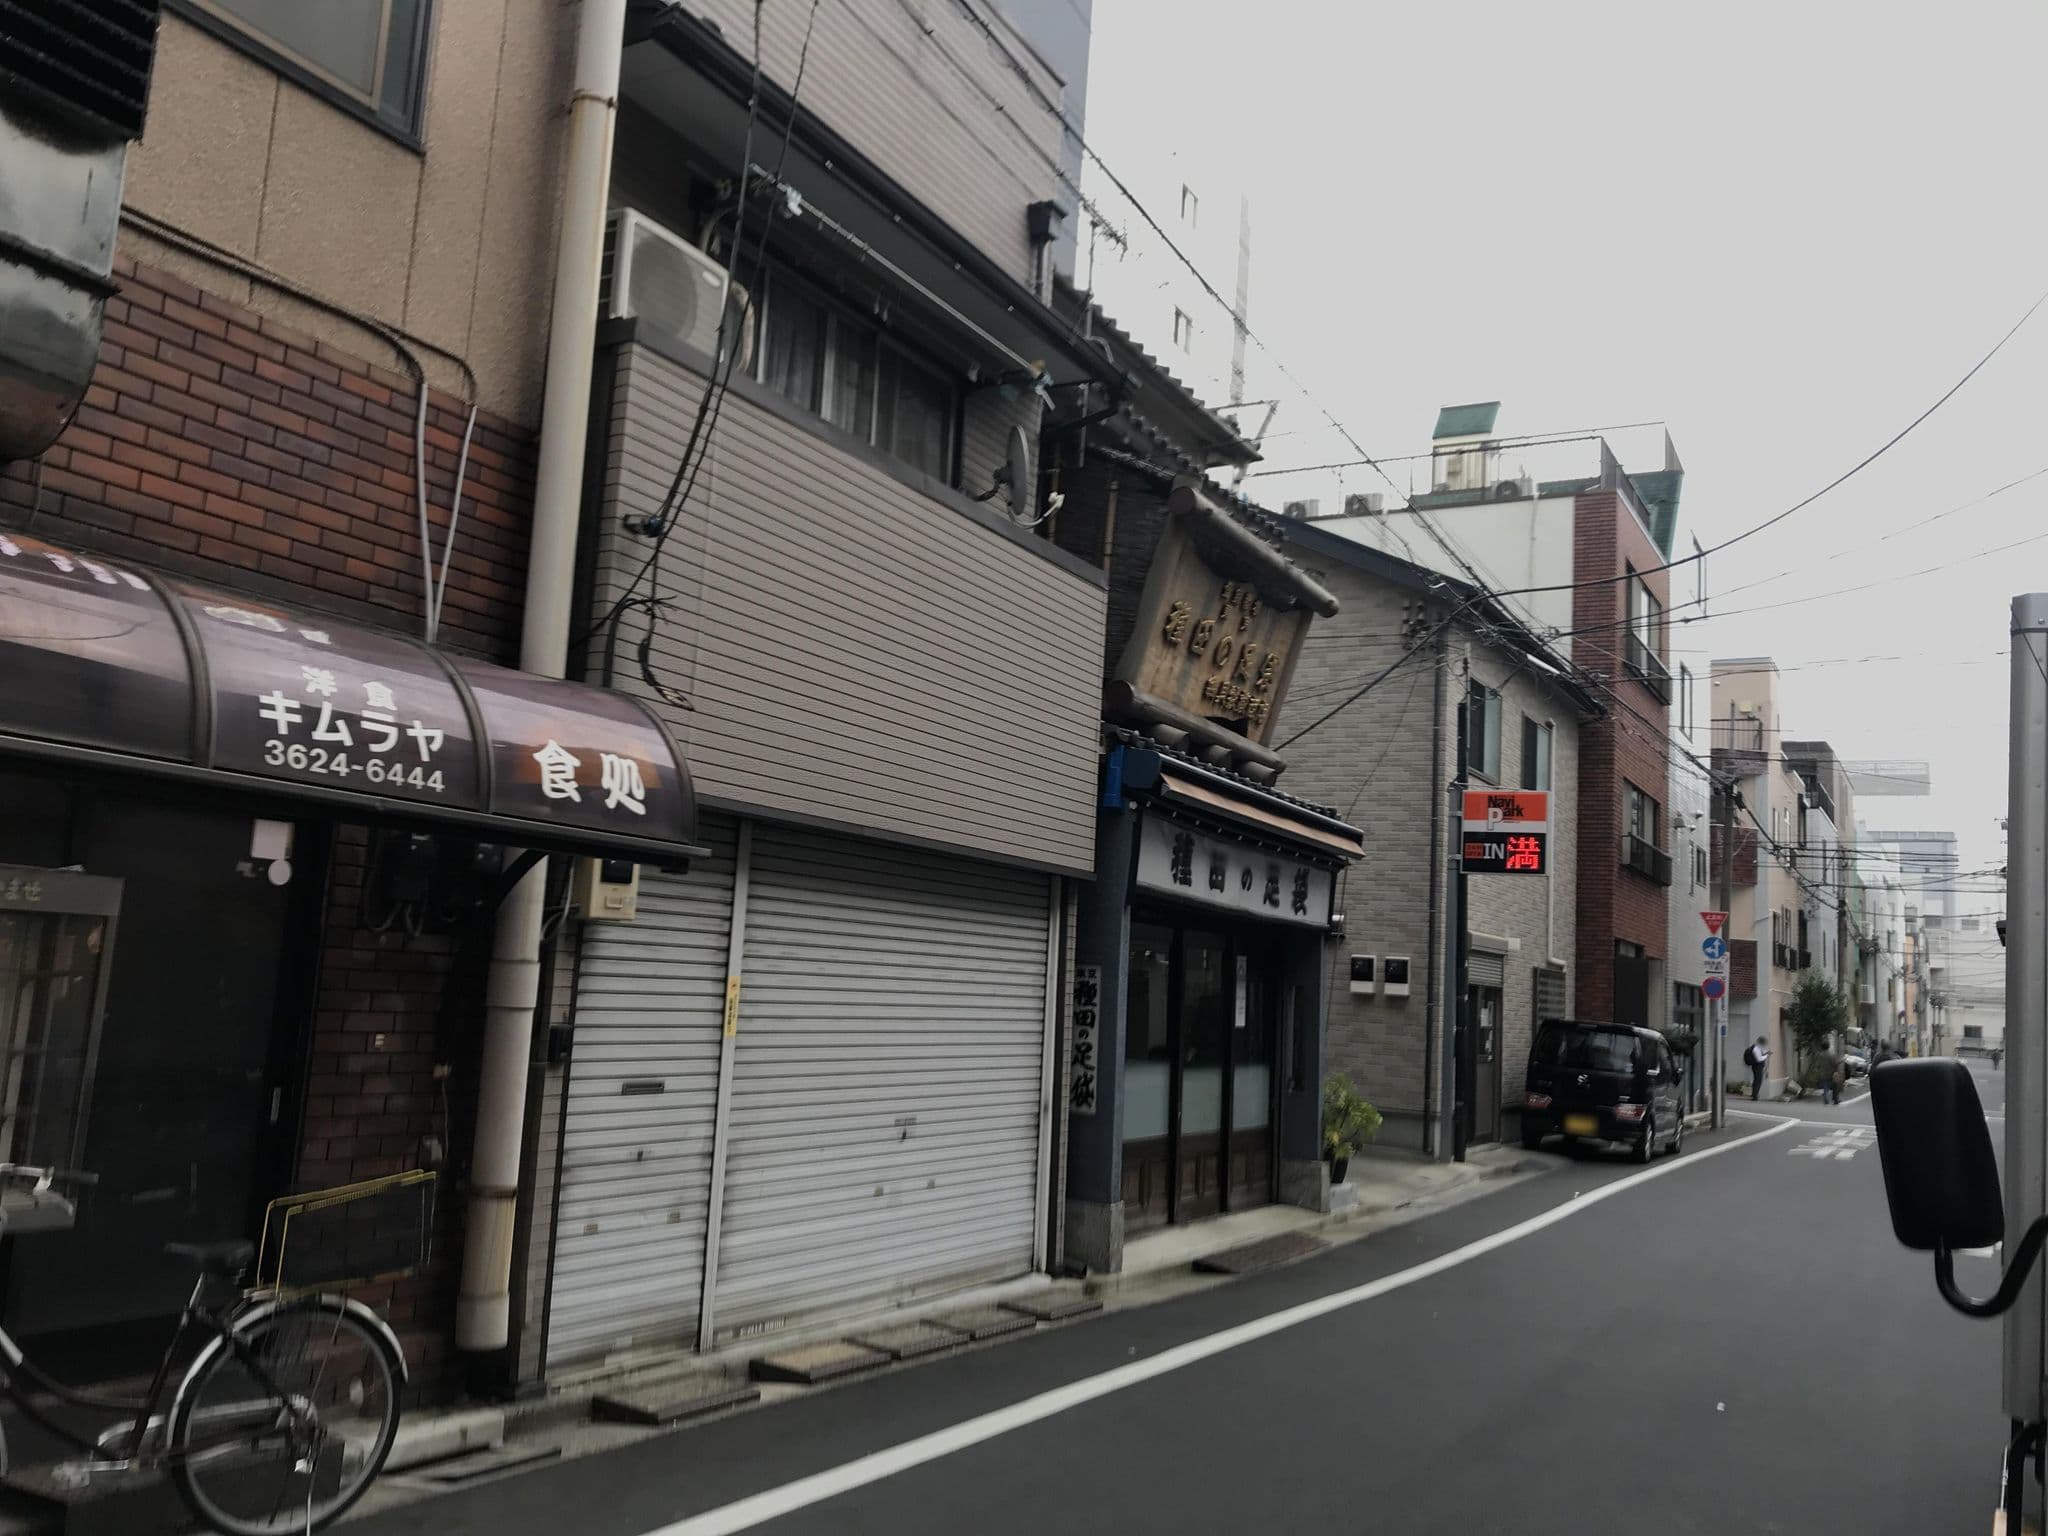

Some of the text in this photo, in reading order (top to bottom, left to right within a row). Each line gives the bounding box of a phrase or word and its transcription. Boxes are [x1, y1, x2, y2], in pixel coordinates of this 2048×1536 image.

[301, 665, 398, 711] 洋食
[259, 690, 444, 762] キムラヤ
[264, 739, 445, 792] 3624-6444
[532, 739, 647, 815] 食処
[1487, 795, 1515, 808] Navi
[1487, 805, 1524, 831] Park
[1483, 843, 1505, 860] IN
[1505, 836, 1541, 871] 満
